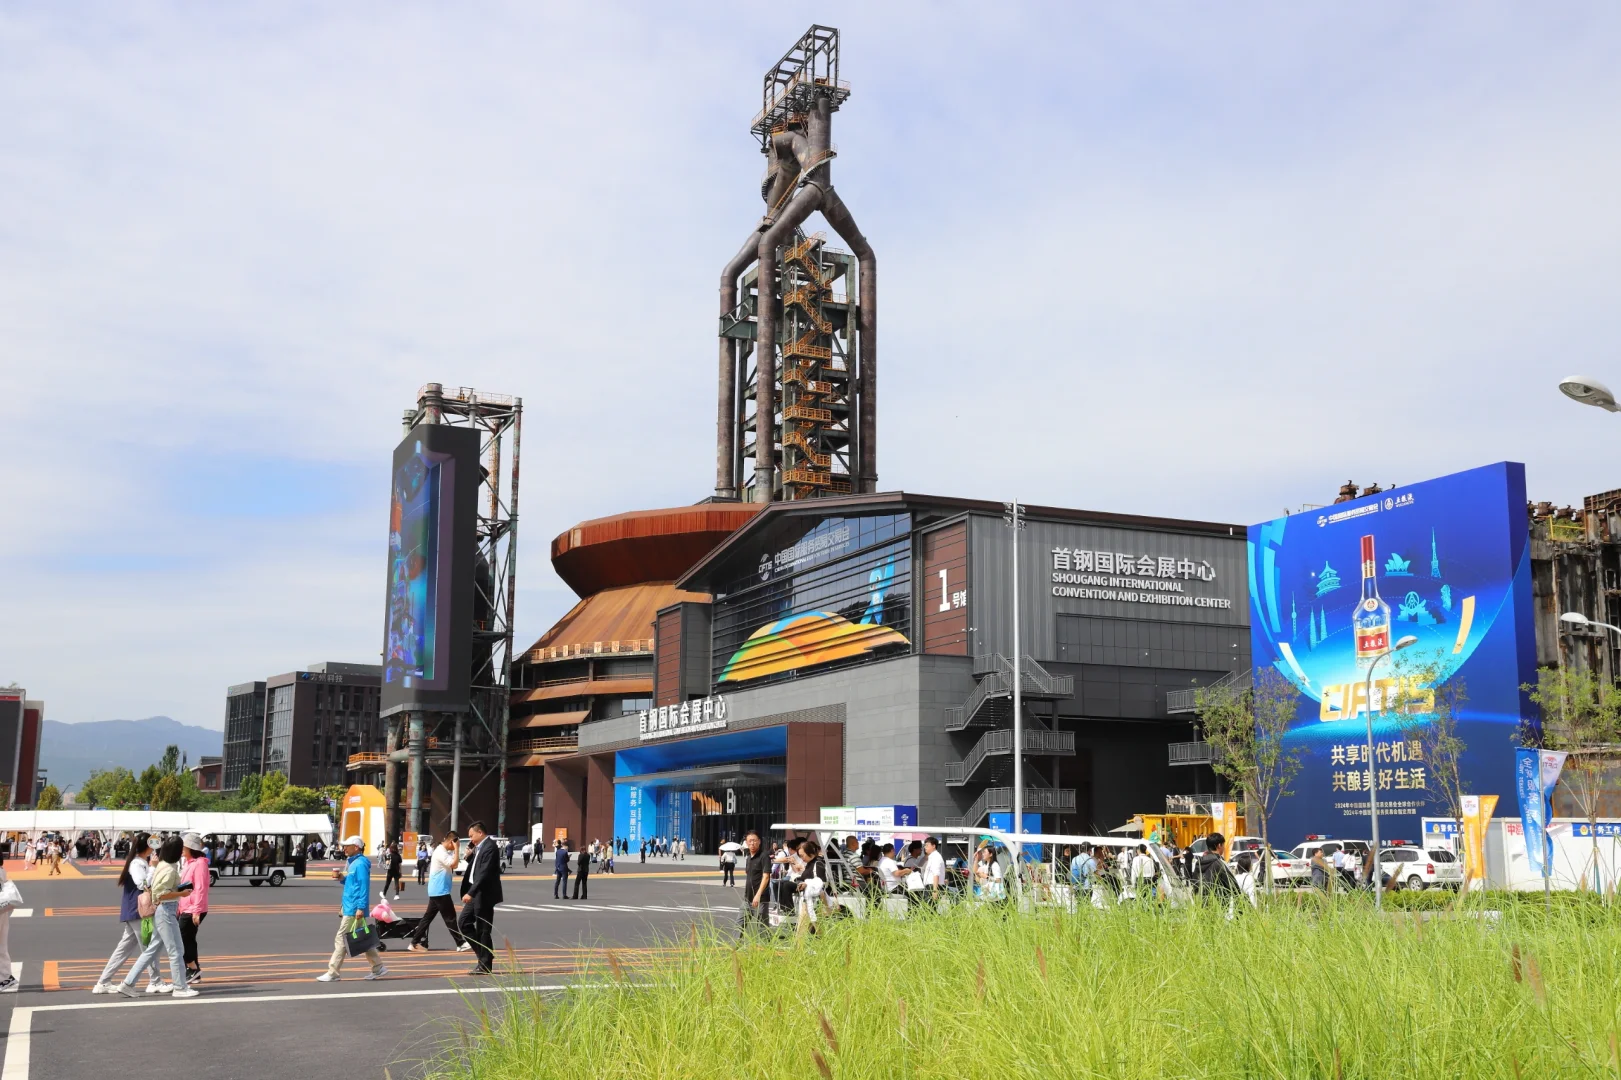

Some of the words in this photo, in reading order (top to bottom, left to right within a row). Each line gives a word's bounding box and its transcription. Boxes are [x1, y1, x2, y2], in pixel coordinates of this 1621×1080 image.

[774, 525, 850, 566] 中国国际服务贸易交易会
[1051, 547, 1216, 582] 首钢国际会展中心
[1052, 572, 1108, 586] SHOUGANG
[1109, 576, 1184, 593] INTERNATIONAL
[1052, 586, 1118, 601] CONVENTION
[1118, 591, 1139, 602] AND
[1139, 592, 1194, 606] EXHIBITION
[1194, 596, 1231, 609] CENTER
[1320, 674, 1435, 722] CIFTIS
[639, 694, 726, 733] 首钢国际会展中心
[1331, 740, 1424, 766] 共享时代机遇
[1332, 767, 1427, 792] 共酿美好生活
